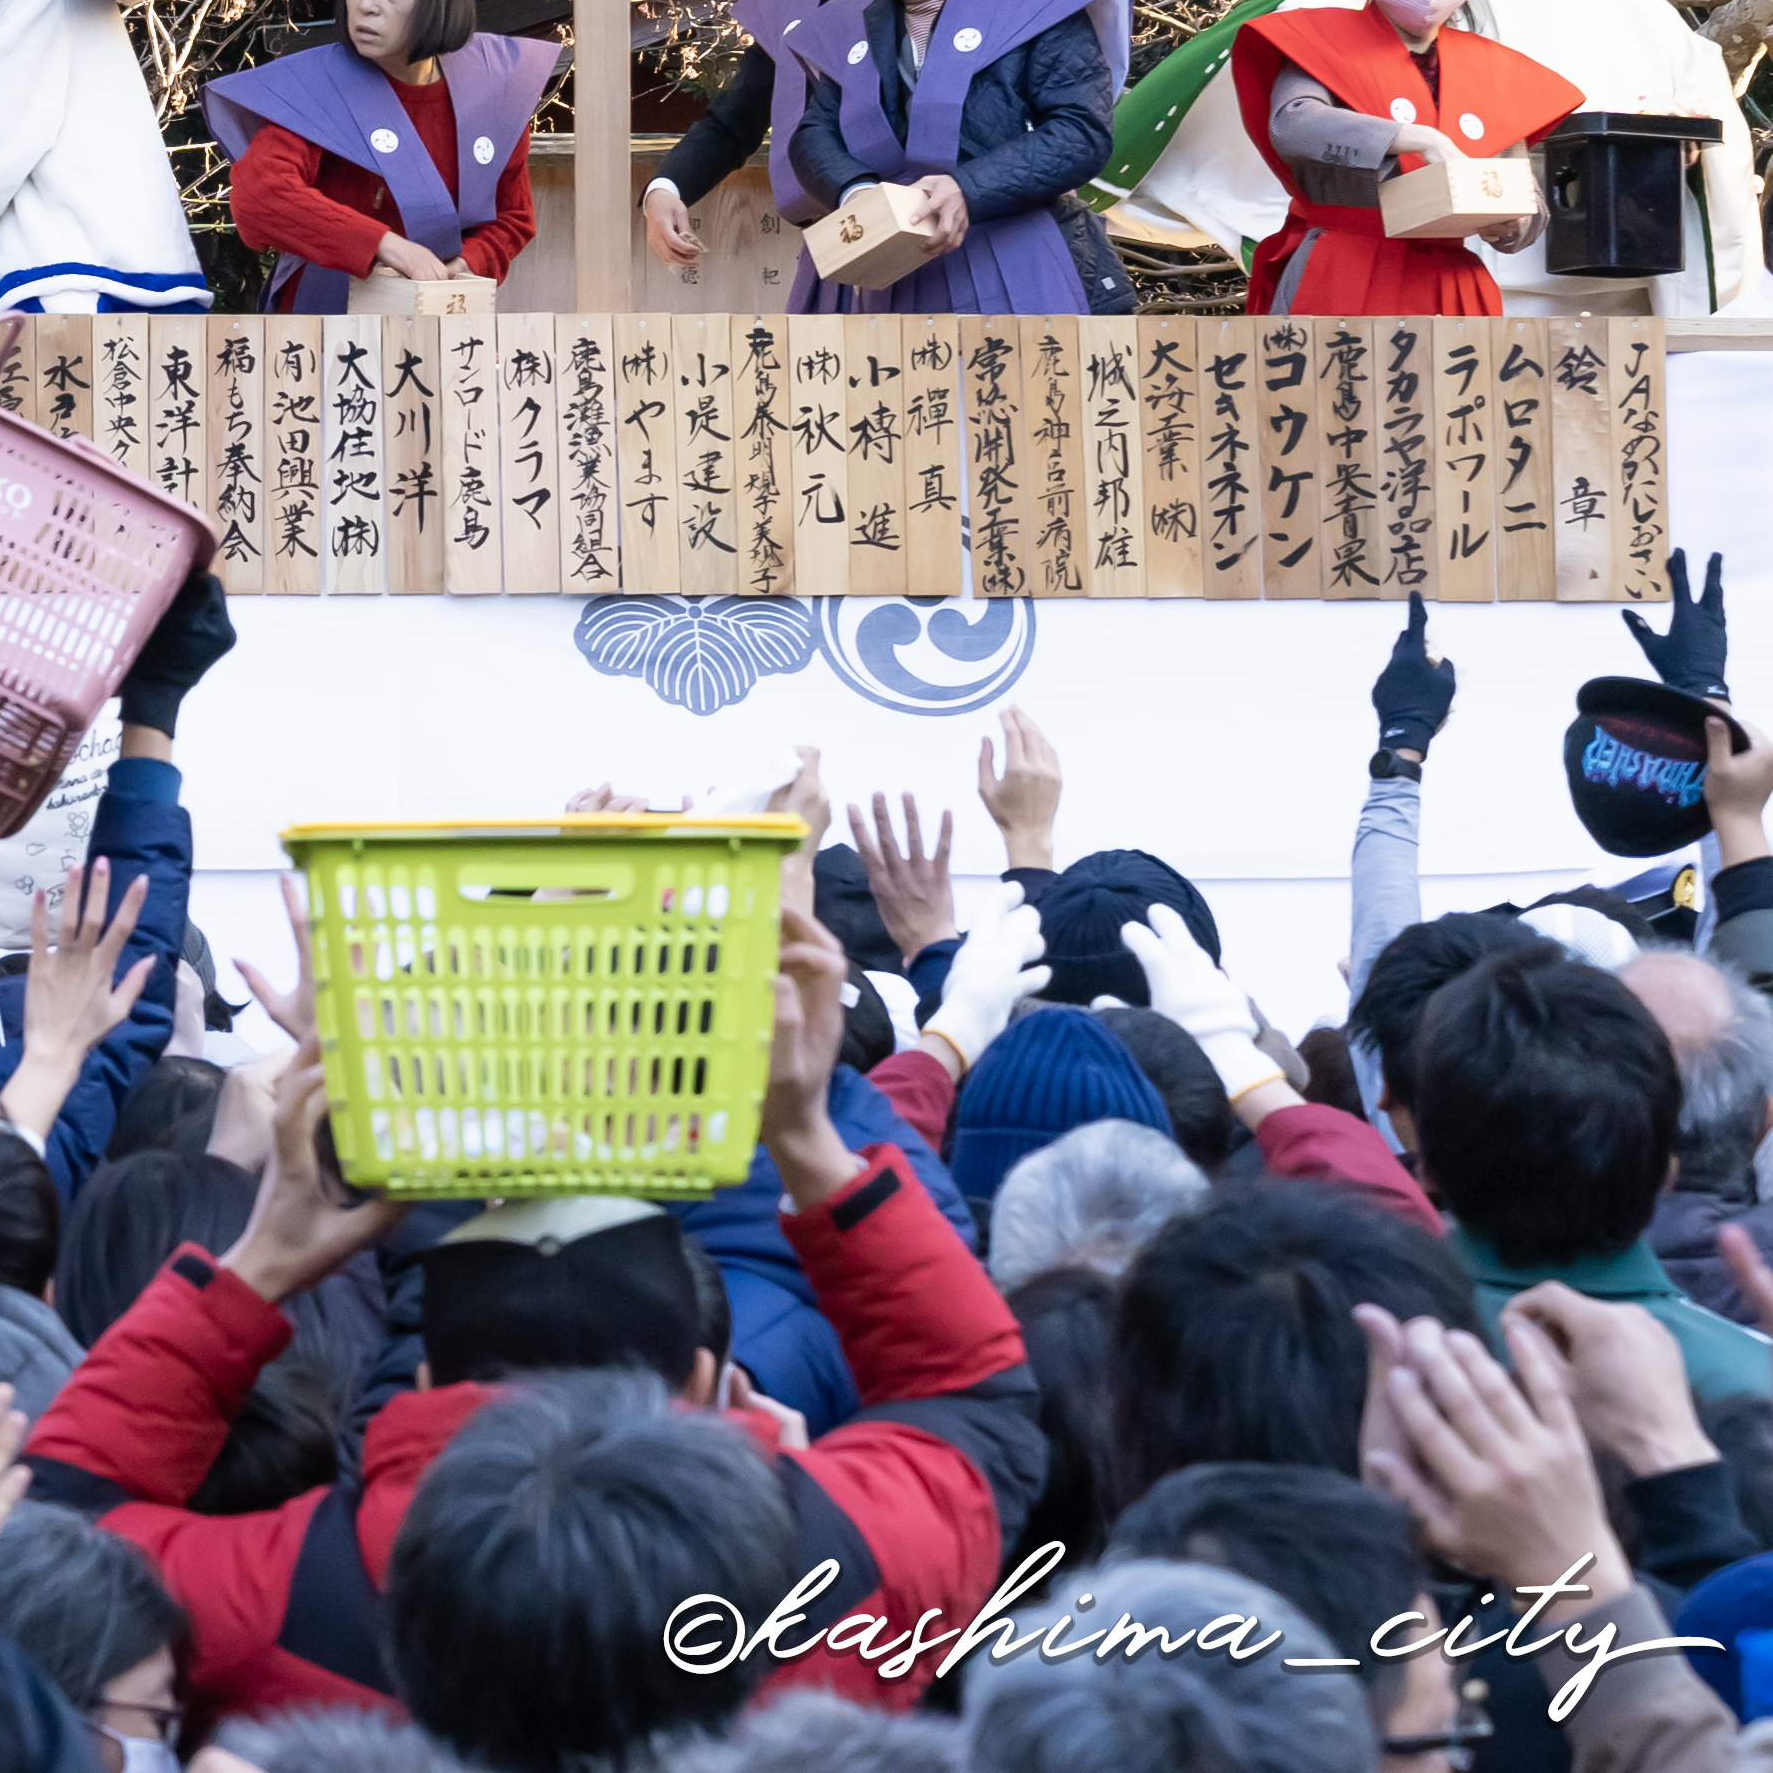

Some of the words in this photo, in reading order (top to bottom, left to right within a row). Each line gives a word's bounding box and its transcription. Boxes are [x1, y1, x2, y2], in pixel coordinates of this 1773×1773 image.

[837, 214, 866, 246] 福
[213, 337, 263, 564] 福もち奉納会
[384, 348, 439, 536] 大川洋
[447, 335, 493, 551] サンロード鹿島
[1029, 333, 1083, 592] 鹿島神宮前病院
[1086, 339, 1138, 571] 城之内邦雄
[1204, 351, 1259, 572] セキネネオン
[1319, 330, 1381, 589] 鹿島中央青果
[1379, 329, 1434, 587] タカラヤ洋品店
[1443, 344, 1490, 561] ラポワール
